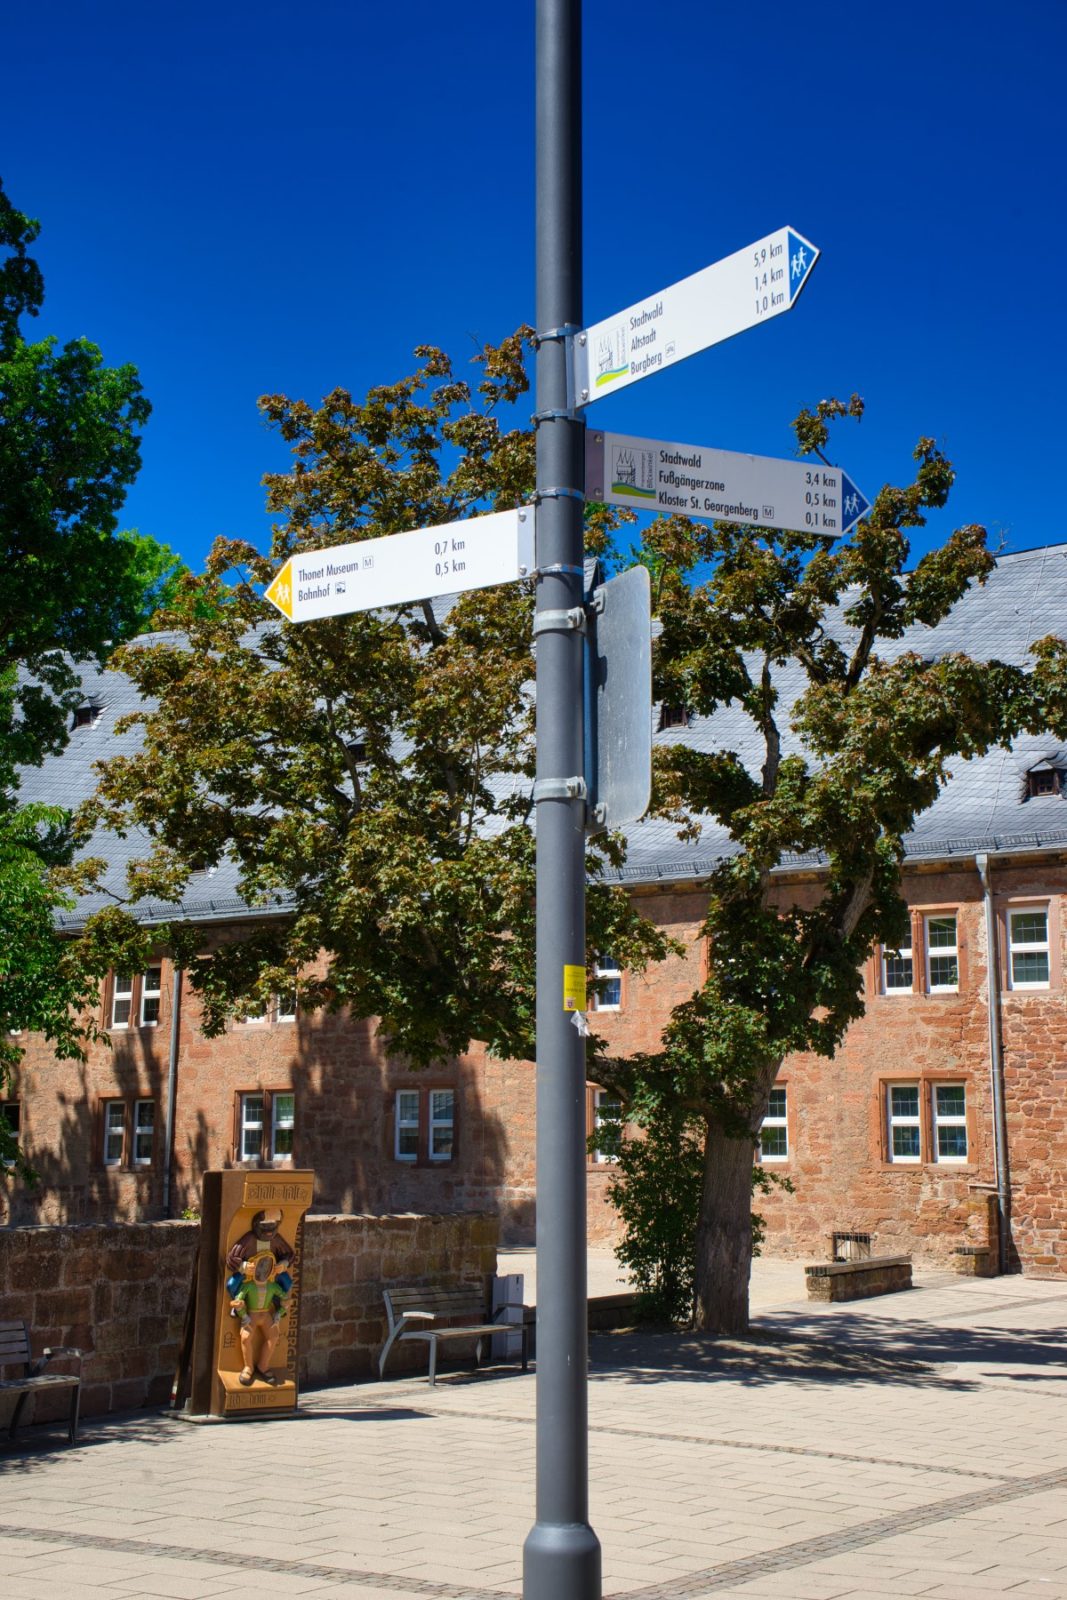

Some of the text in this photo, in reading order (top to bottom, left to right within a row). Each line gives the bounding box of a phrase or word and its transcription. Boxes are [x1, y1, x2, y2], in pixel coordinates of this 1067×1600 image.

[754, 242, 782, 268] 5,9 km
[754, 266, 784, 292] 1,4 km
[755, 290, 784, 315] 1,0 km
[630, 302, 663, 330] Stadtwald
[631, 330, 656, 352] Altstadt
[630, 350, 662, 374] Burgberg
[660, 450, 701, 468] Stadtwald
[659, 471, 725, 492] Fußgängerzone
[805, 472, 836, 487] 3,4 km
[658, 492, 688, 508] Kloster
[690, 496, 701, 510] St.
[704, 499, 759, 520] Georgenberg
[805, 492, 836, 508] 0,5 km
[805, 512, 836, 528] 0,1 km
[434, 539, 465, 556] 0,7 km
[298, 568, 324, 582] Thonet
[326, 562, 358, 577] Museum
[435, 560, 466, 578] 0,5 km
[298, 584, 330, 601] Bahnhof
